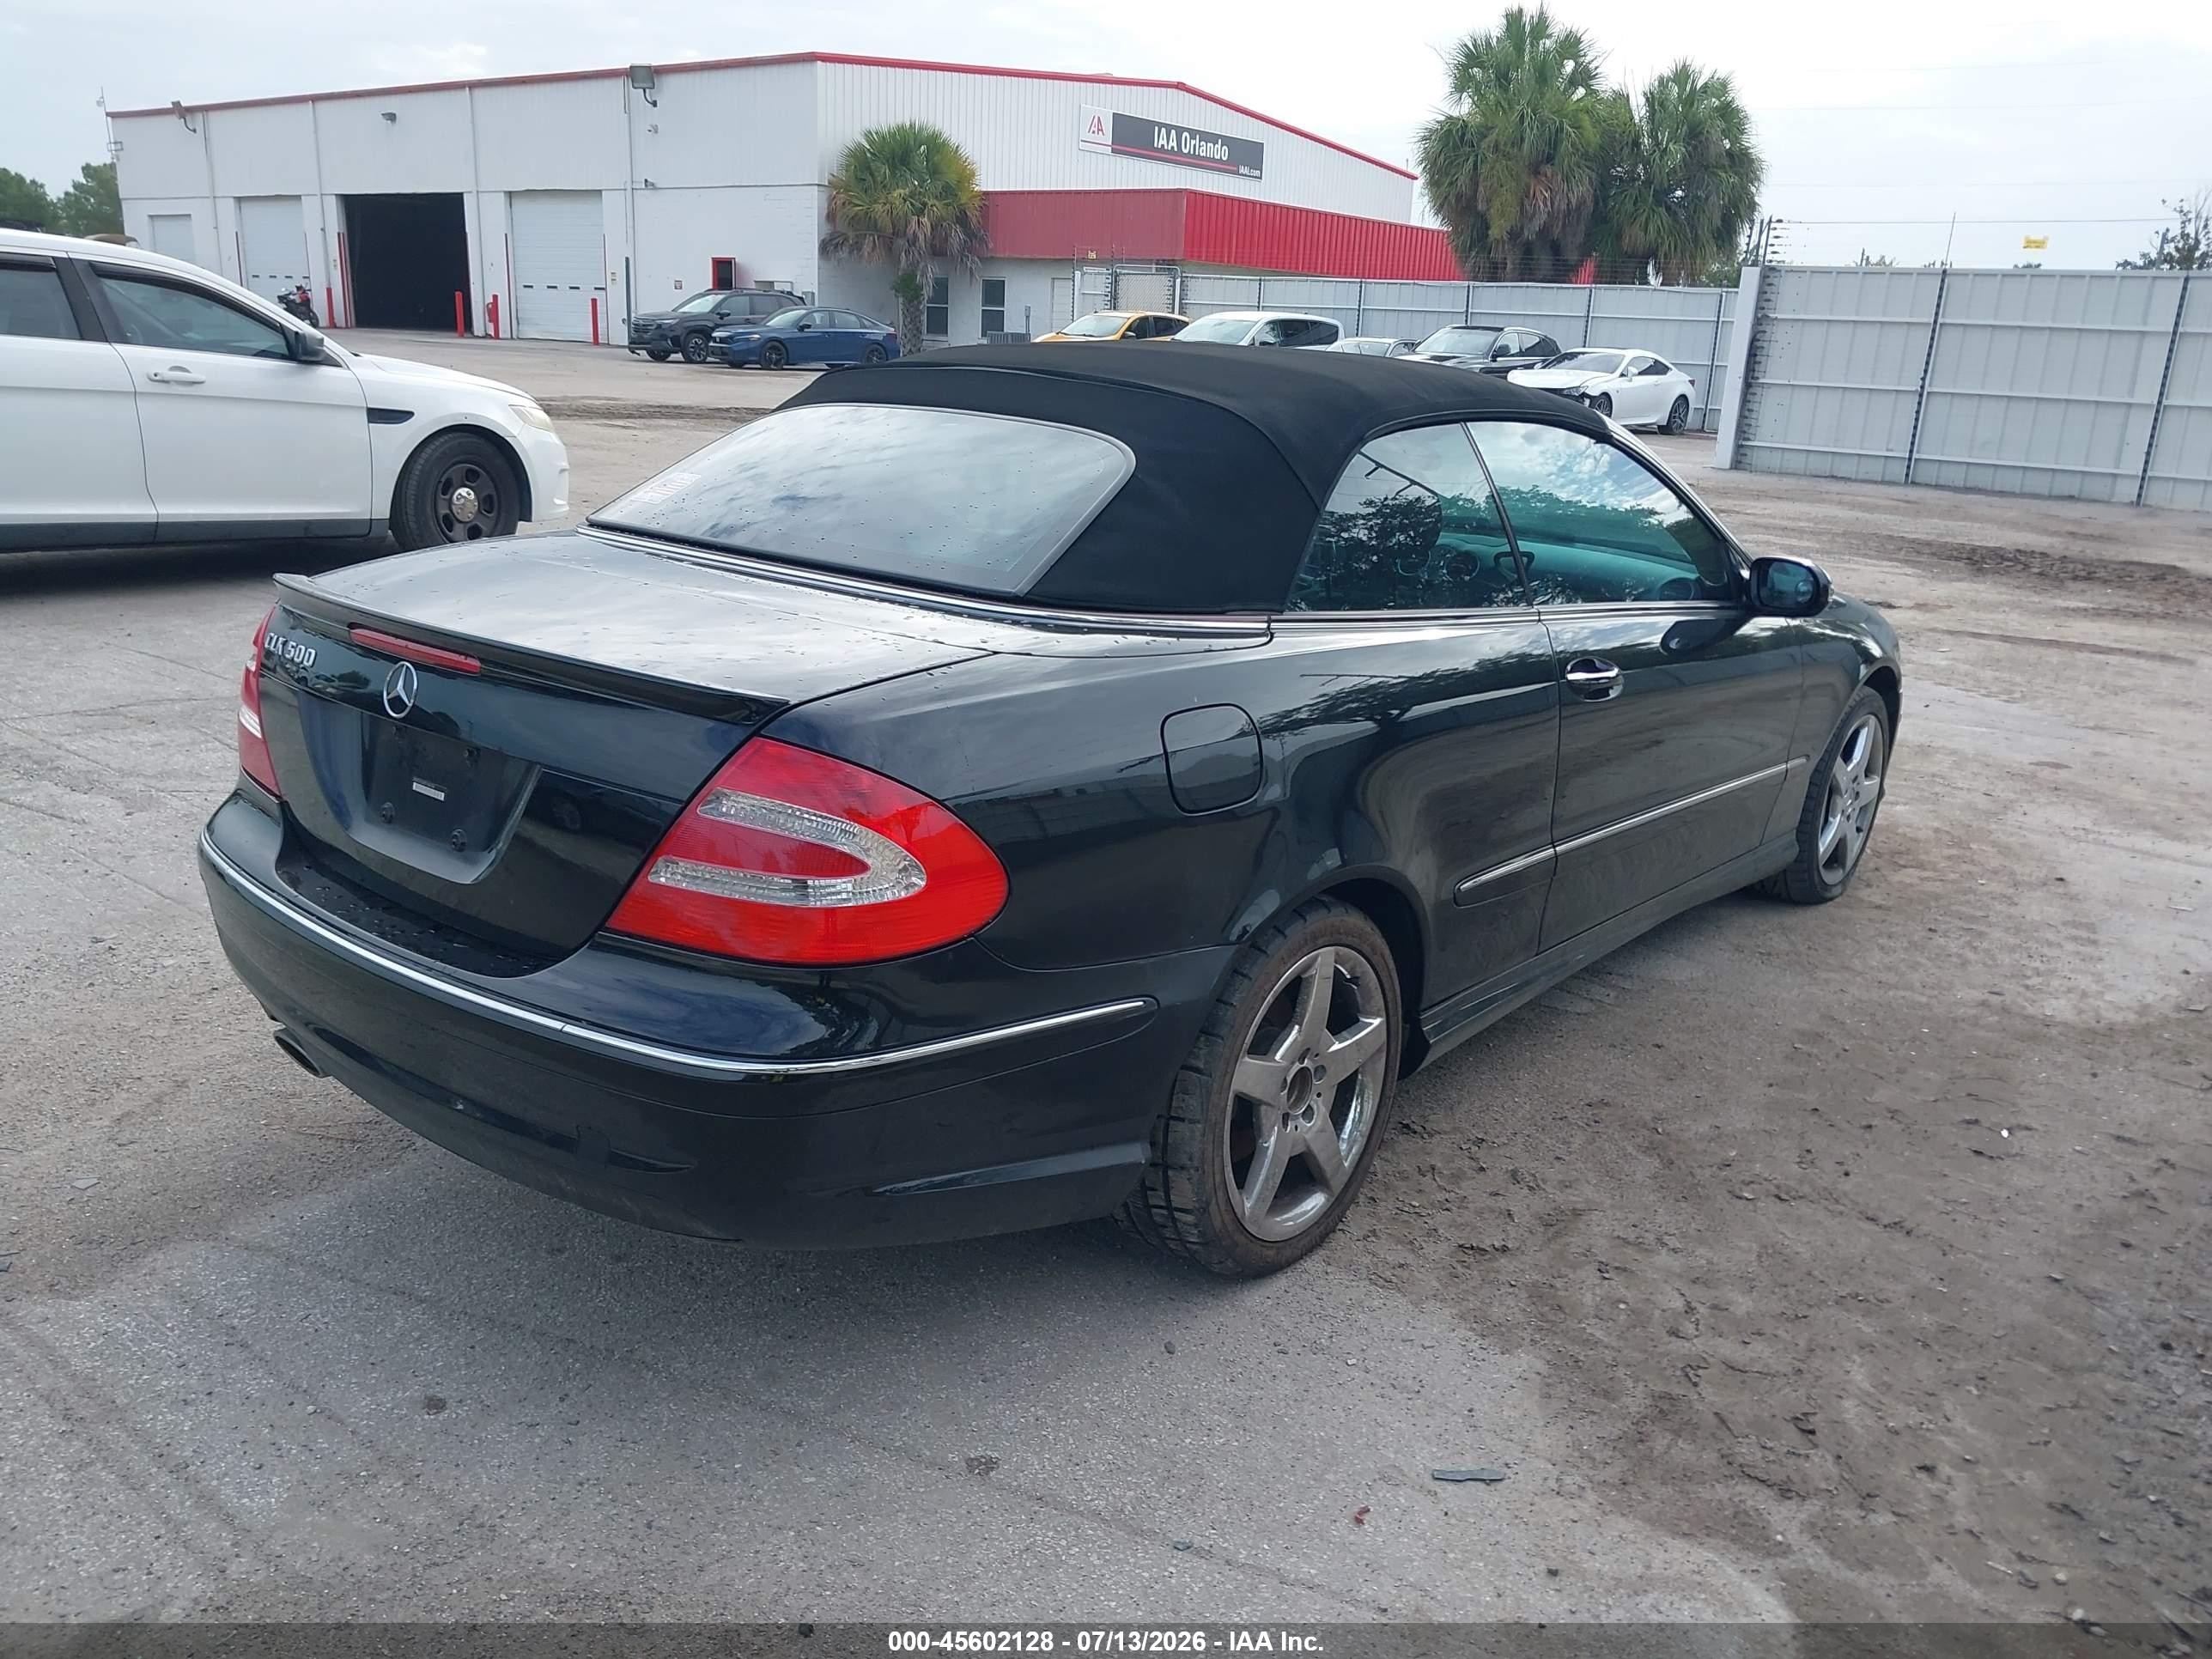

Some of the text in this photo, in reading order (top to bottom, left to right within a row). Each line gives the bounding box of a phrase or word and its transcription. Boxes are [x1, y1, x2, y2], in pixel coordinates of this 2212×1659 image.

[1153, 125, 1229, 161] IAA Orlando
[264, 632, 317, 667] CLK 500
